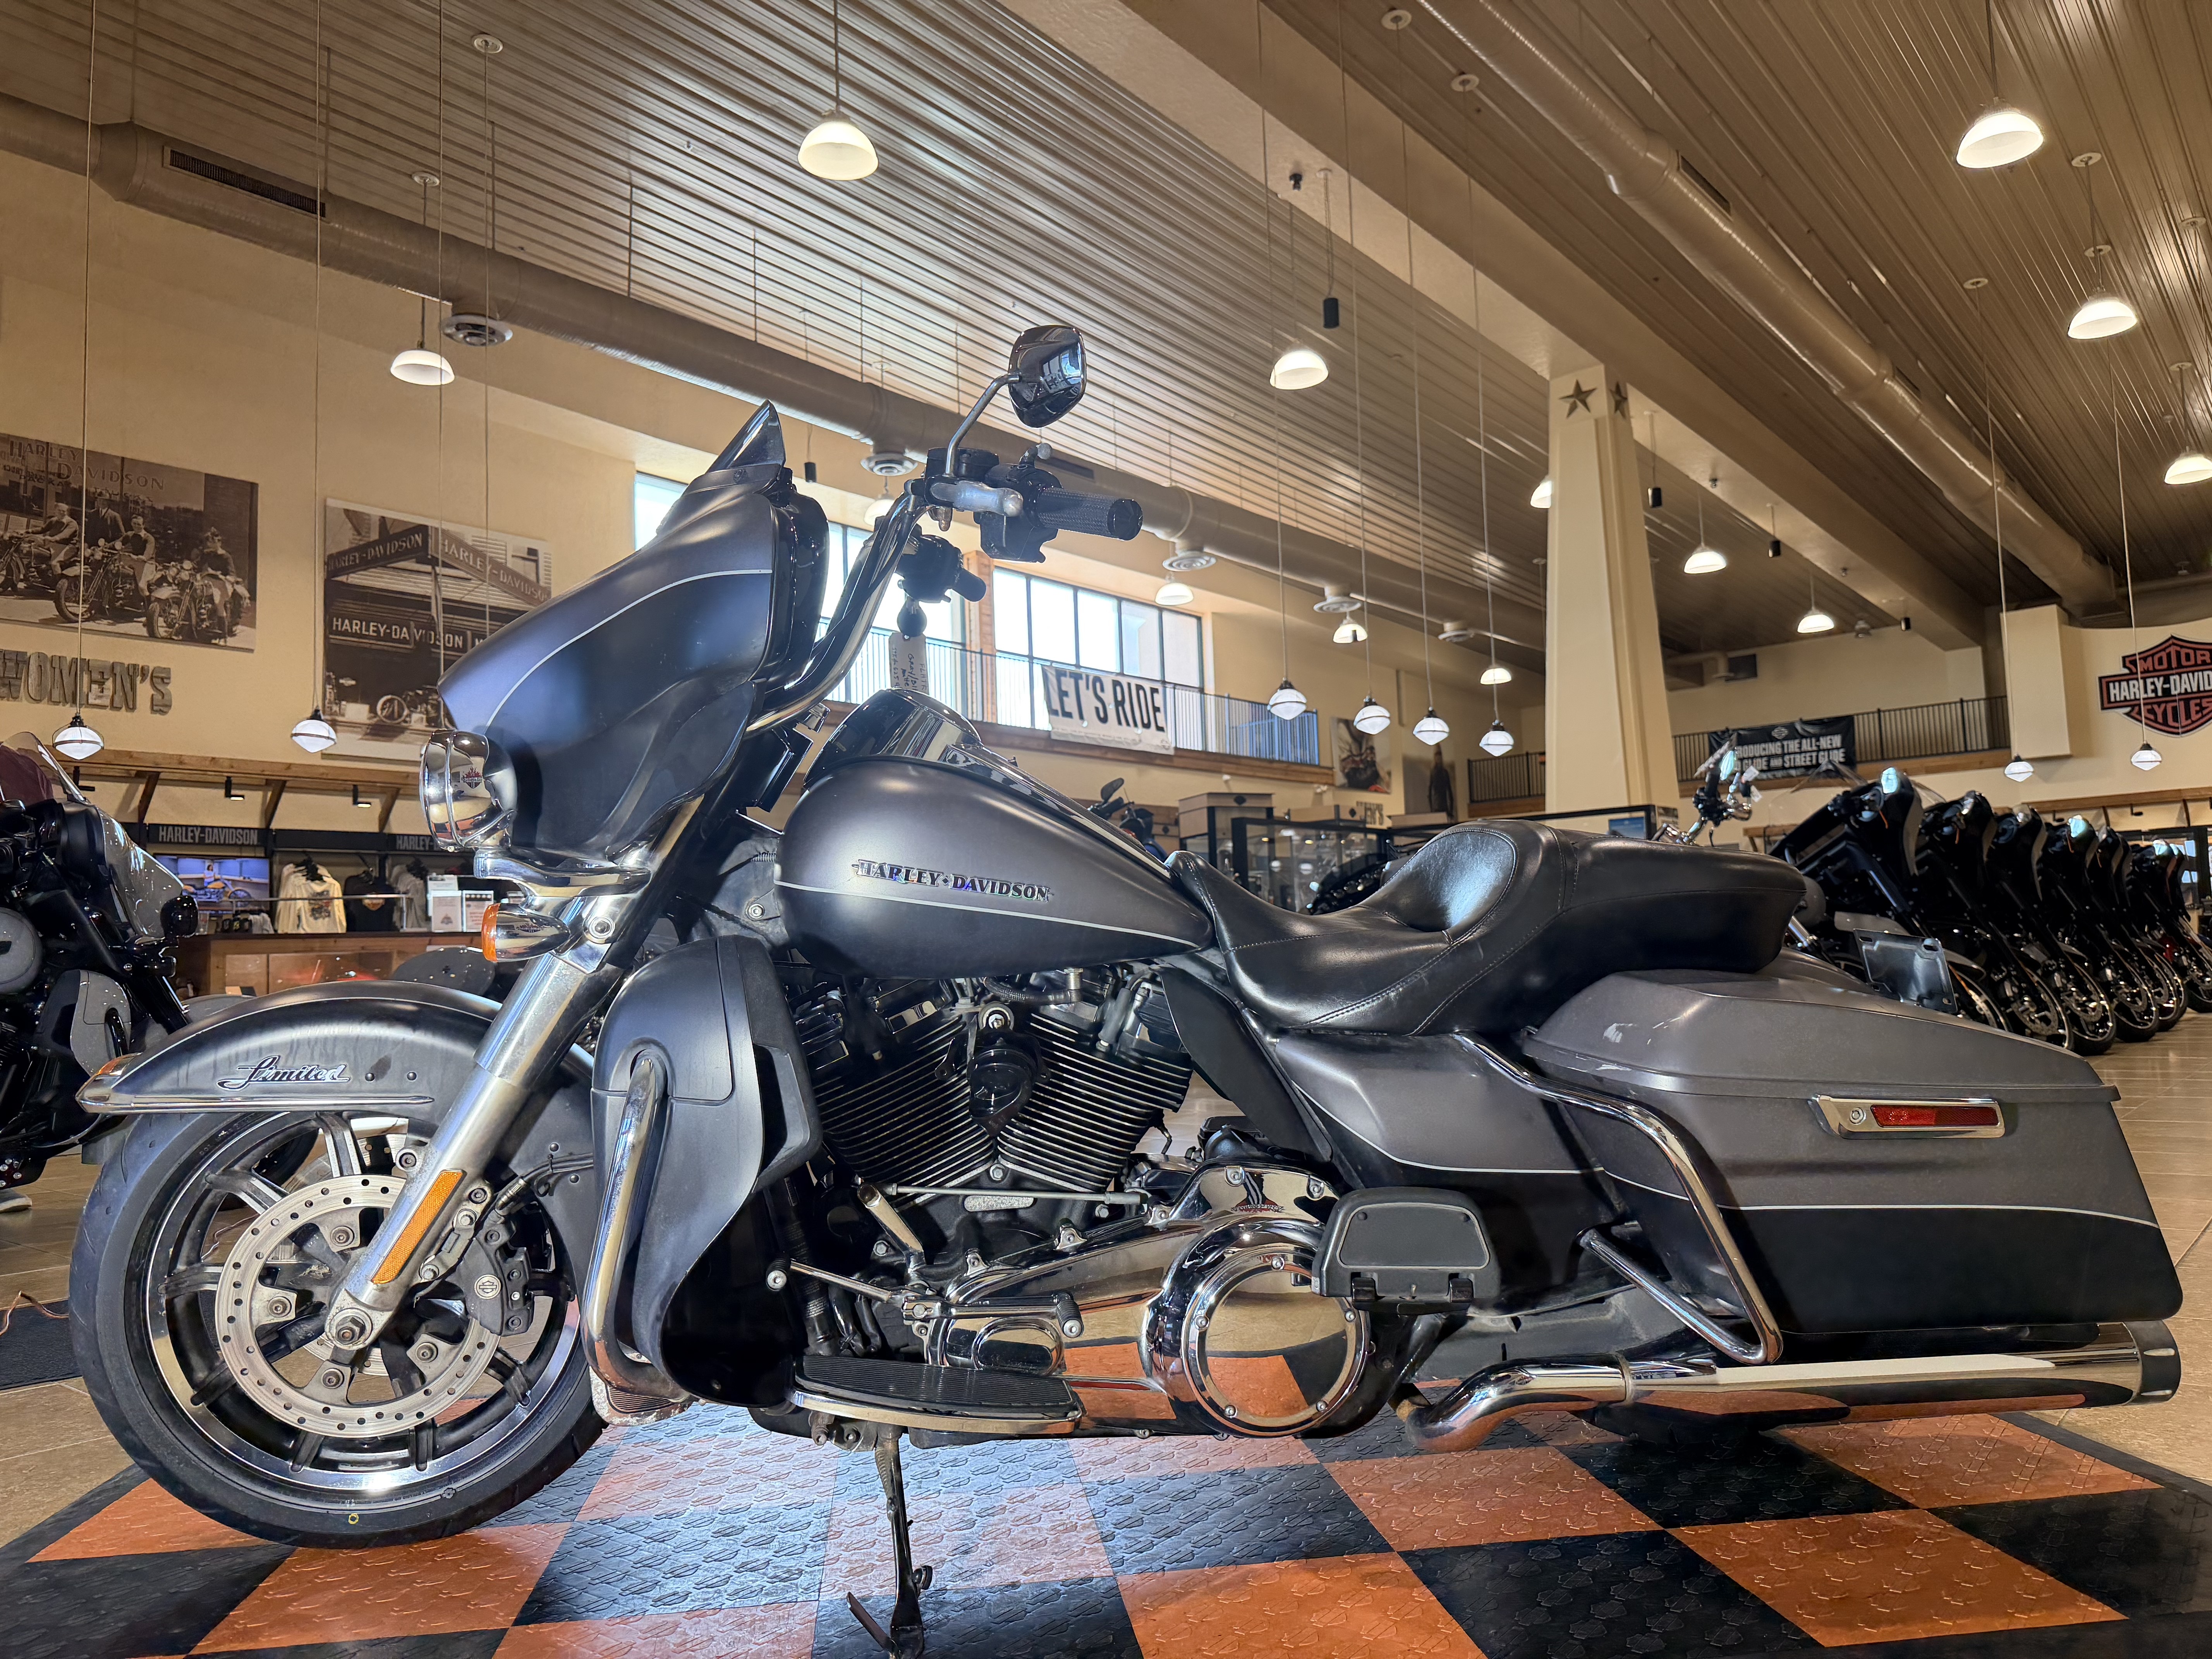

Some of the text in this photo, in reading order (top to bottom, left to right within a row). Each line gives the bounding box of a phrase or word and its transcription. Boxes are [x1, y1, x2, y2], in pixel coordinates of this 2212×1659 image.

[57, 462, 165, 490] DAVIDSON
[441, 539, 548, 601] HARLEY-DAVIDSO
[2139, 646, 2211, 672] MOTOR
[1042, 666, 1165, 732] LET'S RIDE
[2109, 670, 2212, 702] HARLEY-DAVID
[1736, 734, 1841, 758] RODUCING THE ALL-NEW
[1784, 752, 1817, 768] STREET
[158, 825, 258, 845] HARLEY-DAVIDSON
[217, 1055, 351, 1091] Limited
